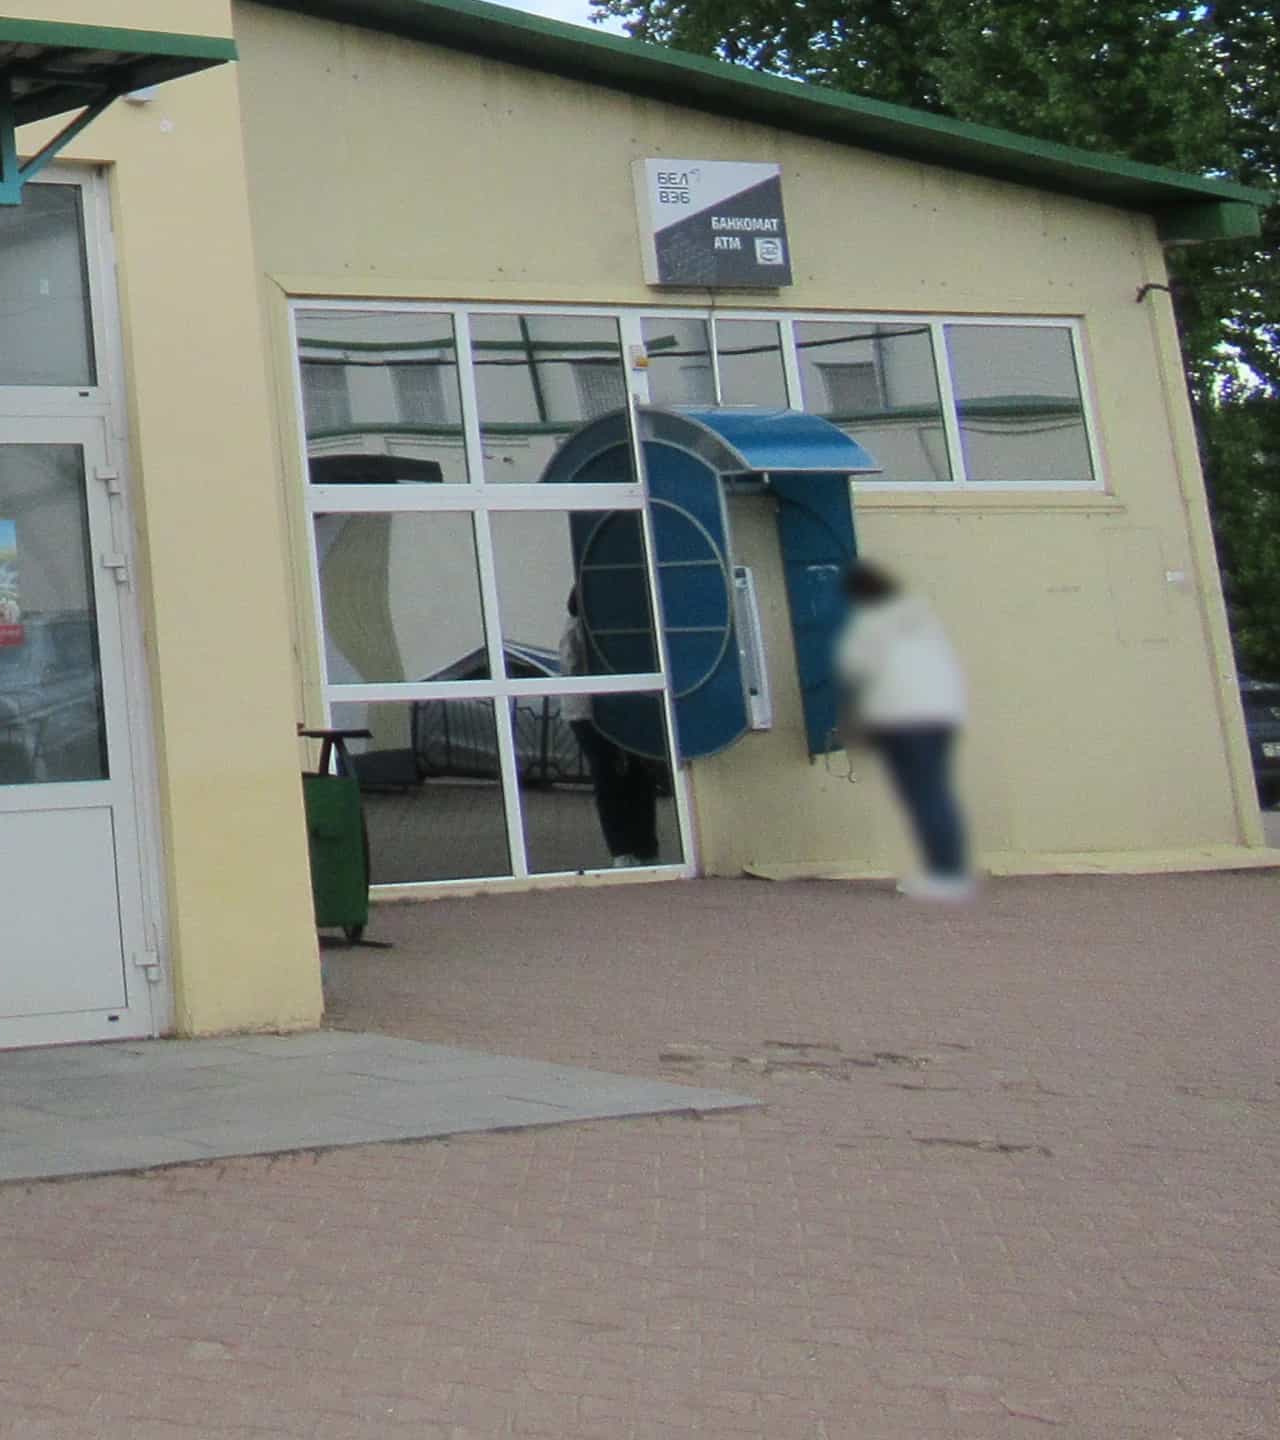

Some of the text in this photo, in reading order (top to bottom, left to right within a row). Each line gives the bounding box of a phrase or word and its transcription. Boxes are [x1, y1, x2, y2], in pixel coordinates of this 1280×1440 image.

[657, 172, 689, 185] БЕЛ
[659, 191, 690, 204] ВЭБ
[711, 216, 778, 231] БАНКОМАТ
[714, 236, 741, 250] ATM
